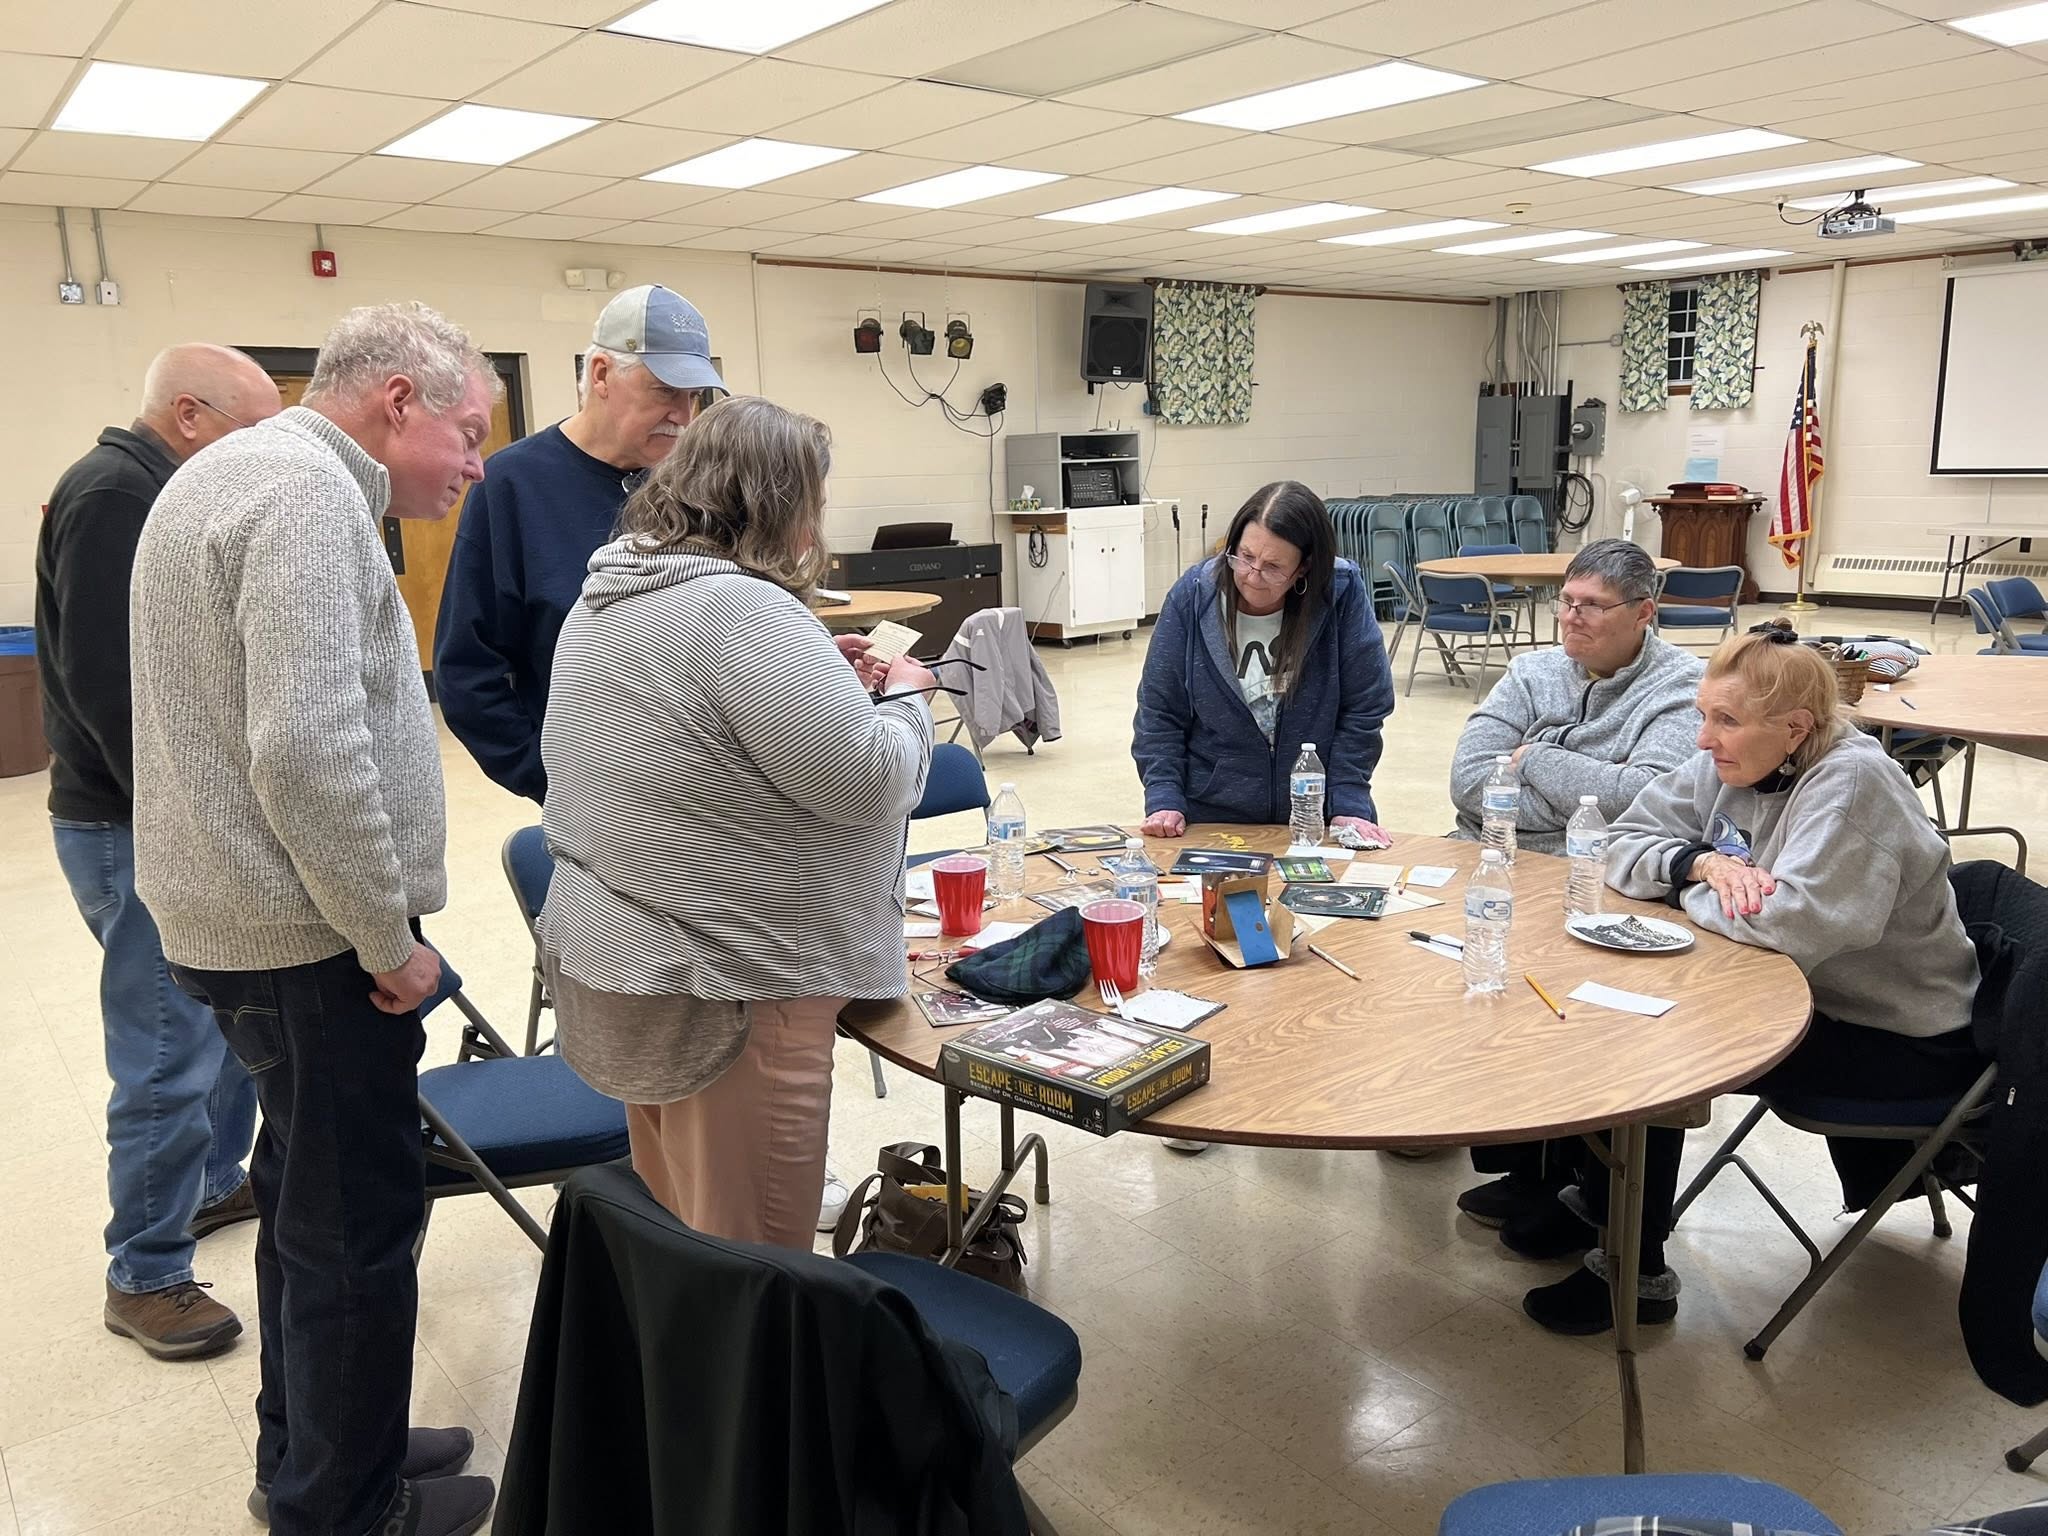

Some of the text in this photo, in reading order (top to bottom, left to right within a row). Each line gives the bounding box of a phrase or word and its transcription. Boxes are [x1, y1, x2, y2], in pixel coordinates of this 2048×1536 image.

[969, 1062, 1074, 1113] ESCAPE THE ROOM
[1127, 1081, 1156, 1110] ESCAPE
[1172, 1062, 1193, 1086] ROOM
